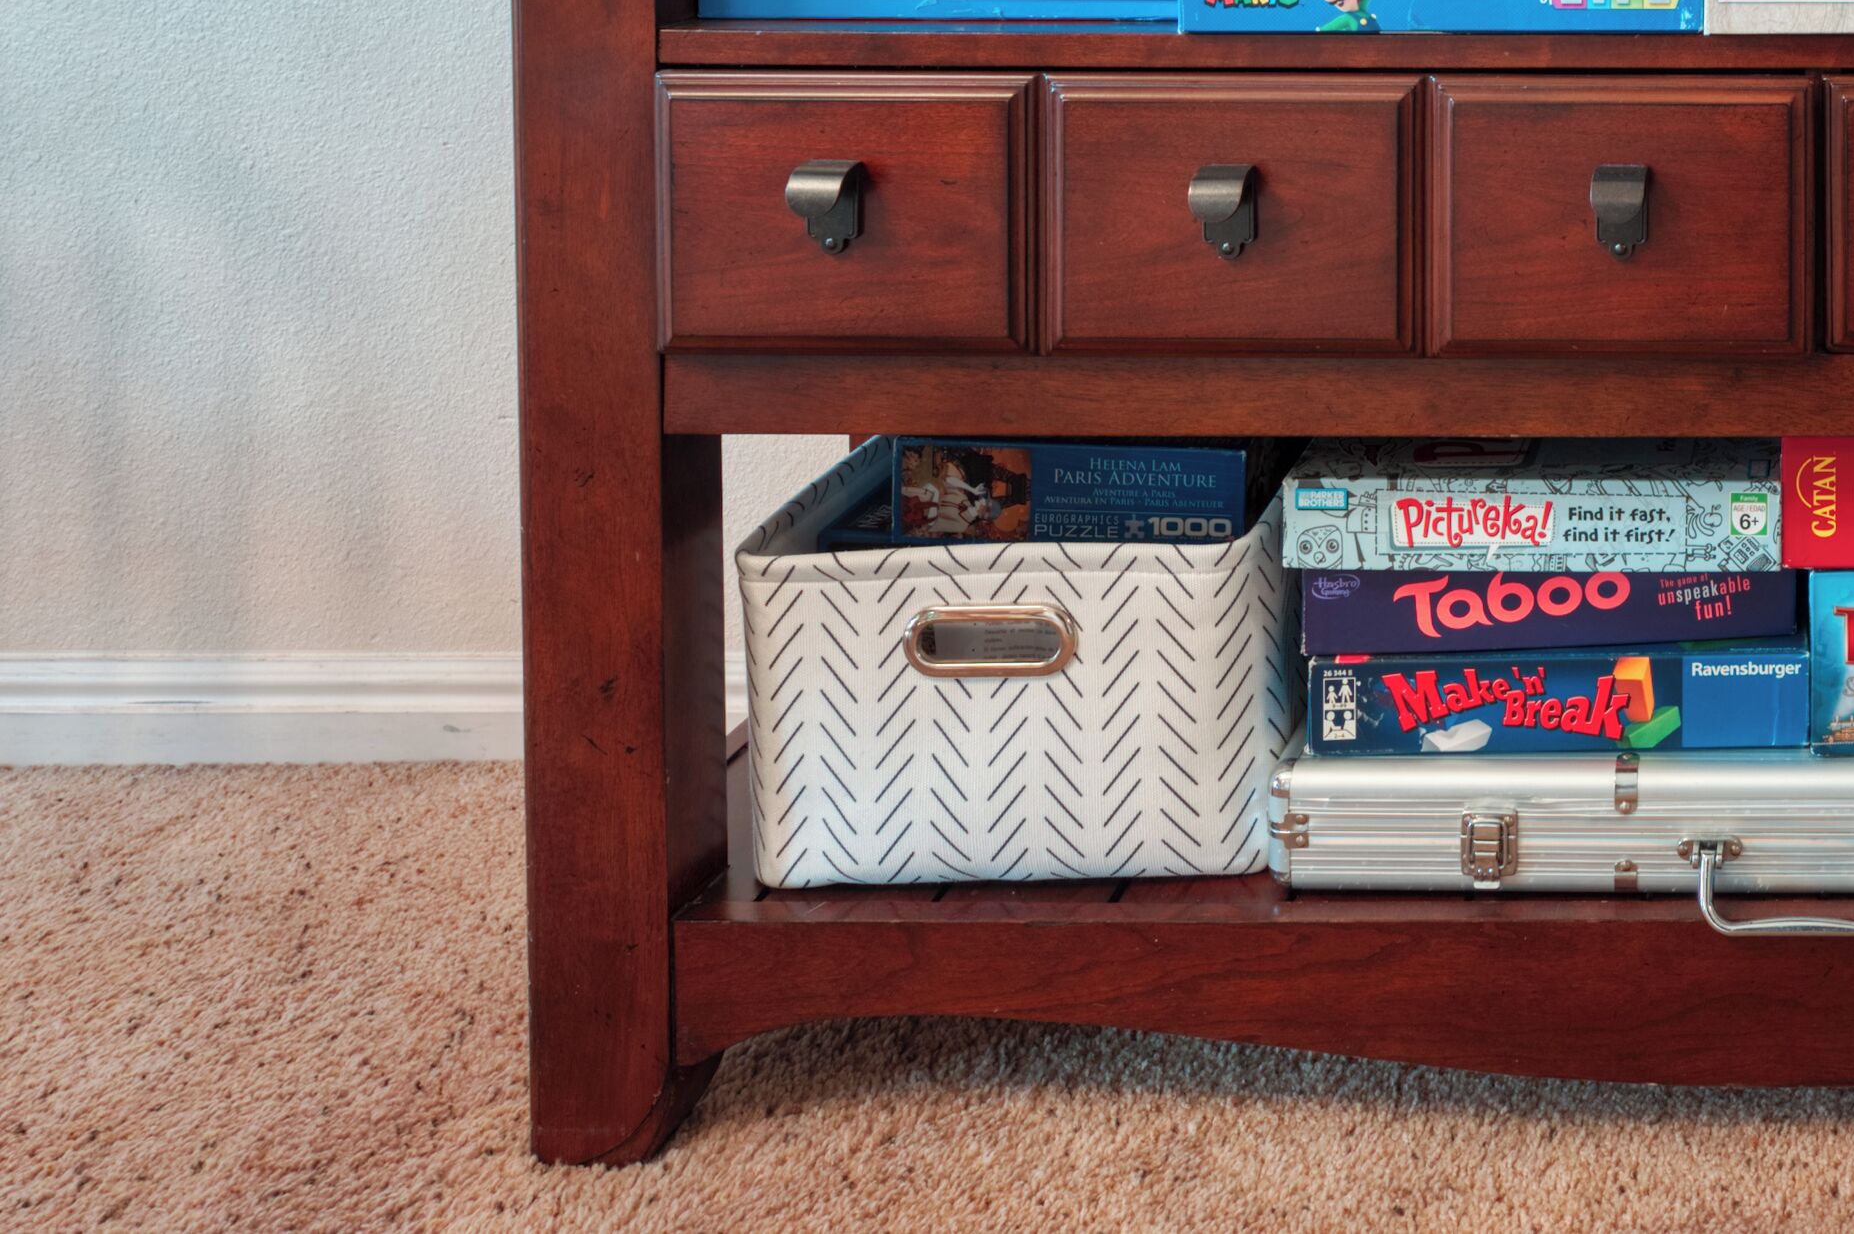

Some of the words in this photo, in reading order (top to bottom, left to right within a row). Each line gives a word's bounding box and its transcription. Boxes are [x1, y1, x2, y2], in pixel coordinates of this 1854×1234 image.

[1089, 457, 1146, 471] HELENA
[1151, 459, 1182, 472] LAM
[1054, 468, 1102, 485] PARIS
[1108, 471, 1217, 488] ADVENTURE
[1092, 487, 1139, 498] AVENTURE
[1151, 489, 1176, 499] PARIS
[1811, 455, 1836, 538] CATAN
[1044, 495, 1092, 505] AVENTURA
[1095, 496, 1107, 505] EN
[1110, 497, 1135, 506] PARIS
[1144, 497, 1169, 507] PARIS
[1172, 498, 1225, 509] ABENTEUER
[1298, 499, 1345, 507] BROTHERS
[1034, 512, 1119, 526] EUROGRAPHICS
[1396, 495, 1554, 549] Pictureka!
[1567, 506, 1603, 522] Find
[1609, 506, 1625, 521] it
[1629, 506, 1671, 524] fast,
[1740, 514, 1759, 530] 6+
[1033, 525, 1119, 539] PUZZLE
[1147, 517, 1232, 538] 1000
[1562, 528, 1598, 543] find
[1603, 528, 1621, 543] it
[1625, 528, 1676, 544] first!
[1313, 576, 1357, 590] Hasbro
[1660, 578, 1674, 589] The
[1677, 575, 1697, 588] game
[1700, 572, 1709, 582] of
[1321, 588, 1350, 598] Gaming
[1658, 574, 1751, 606] unspeakable
[1393, 570, 1631, 638] Taboo
[1695, 595, 1732, 621] fun!
[1333, 669, 1347, 677] 344
[1691, 661, 1802, 679] Ravensburger
[1381, 668, 1511, 734] Make
[1510, 666, 1547, 696] 'n'
[1502, 674, 1631, 741] Break
